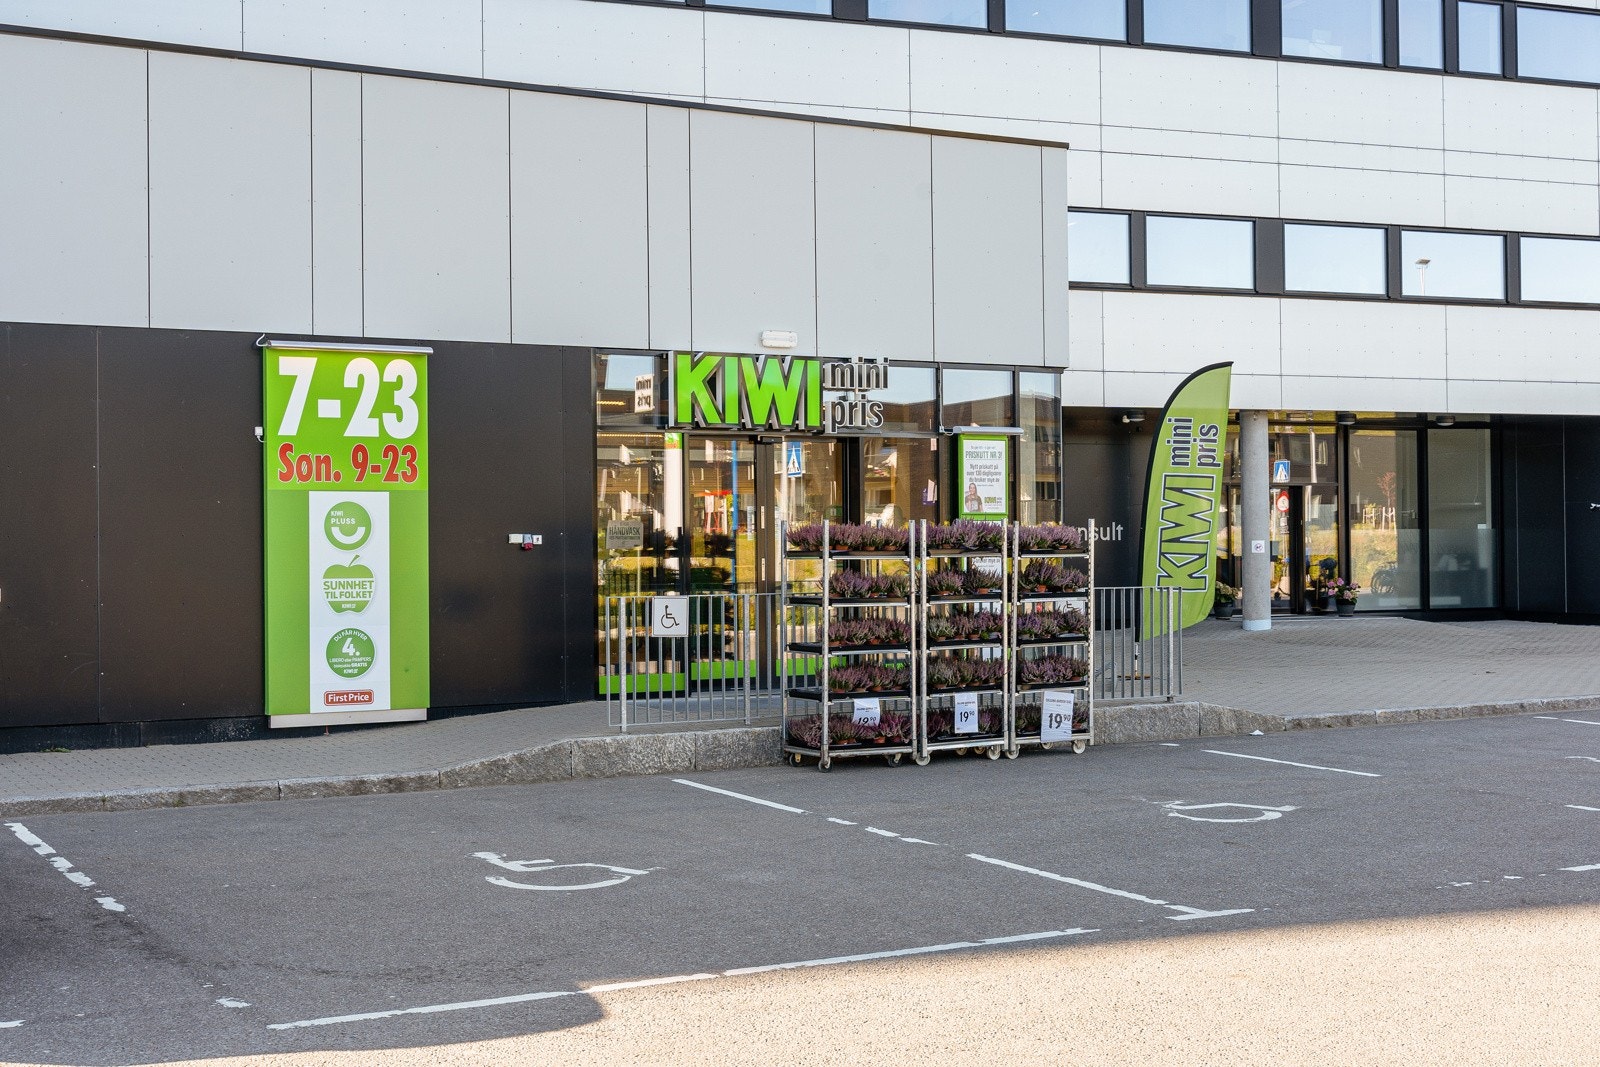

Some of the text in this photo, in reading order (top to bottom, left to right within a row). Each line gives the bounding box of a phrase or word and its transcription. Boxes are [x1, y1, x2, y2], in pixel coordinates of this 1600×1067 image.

[673, 351, 823, 429] KIWI
[828, 357, 889, 390] mini
[277, 356, 419, 439] 7-23
[830, 394, 884, 433] pris
[1166, 417, 1193, 467] mini
[1193, 424, 1221, 468] pris
[278, 442, 418, 484] Søn. 9-23
[608, 525, 640, 536] HÅNDVASK
[1077, 522, 1124, 541] nsult
[1156, 473, 1216, 592] KIWI
[323, 580, 374, 590] SUNNHET
[340, 591, 372, 599] FOLKET
[342, 638, 360, 656] 4.
[353, 630, 367, 641] HVER
[349, 693, 369, 701] Price
